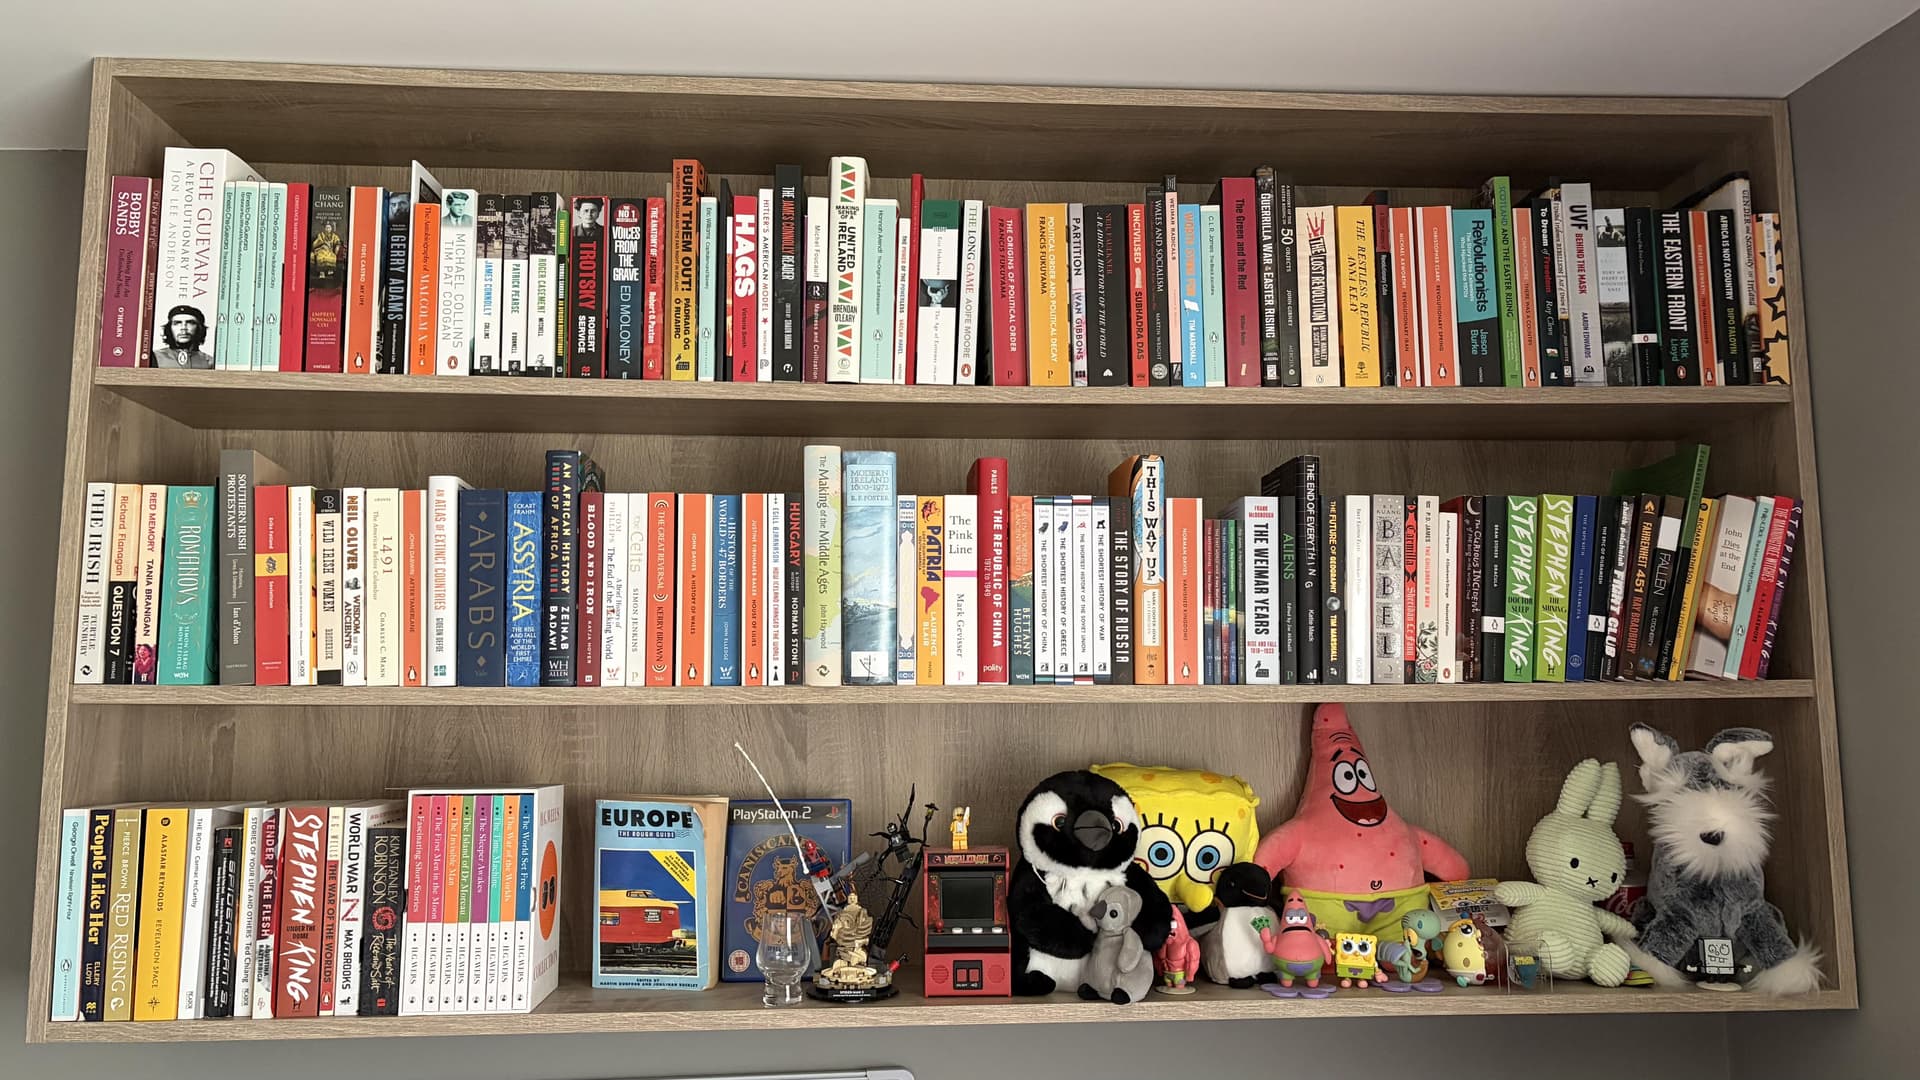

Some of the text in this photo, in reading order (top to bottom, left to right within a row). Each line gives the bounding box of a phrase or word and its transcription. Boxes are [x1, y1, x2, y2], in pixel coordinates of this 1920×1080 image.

[116, 192, 129, 236] SANDS
[129, 192, 142, 238] BOBBY
[166, 170, 182, 288] JON LEE ANDERSON
[182, 172, 194, 273] REVOLUTIONARY
[192, 162, 215, 298] CHE GUEVARA
[612, 226, 640, 240] VOICES
[614, 240, 638, 253] FROM
[681, 165, 693, 292] BURN THEM OUT!
[837, 221, 847, 272] IRELAND
[846, 226, 856, 269] UNITED
[968, 206, 977, 226] THE
[968, 229, 977, 260] LONG
[1569, 204, 1588, 231] UVF
[179, 276, 188, 299] LIFE
[387, 235, 406, 320] GERRY ADAMS
[578, 241, 597, 310] TROTSKY
[613, 268, 639, 281] GRAVE
[618, 254, 634, 267] THE
[735, 214, 755, 297] HAGS
[966, 262, 975, 293] GAME
[1471, 220, 1487, 312] Revolutionists
[1575, 233, 1586, 295] BEHIND THE MASK
[1662, 212, 1688, 332] THE EASTERN FRONT
[442, 241, 454, 341] TIM PAT COOGAN
[453, 234, 466, 349] MICHAEL COLLINS
[618, 285, 631, 364] ED MOLONEY
[962, 326, 972, 359] MOORE
[1470, 330, 1478, 355] Burke
[1479, 329, 1488, 355] Jason
[86, 489, 105, 583] THE IRISH
[116, 496, 128, 576] Richard Flanagan
[147, 512, 156, 552] MEMORY
[227, 474, 236, 539] PROTESTANTS
[238, 474, 247, 550] SOUTHERN IRISH
[346, 496, 358, 570] NEIL OLIVER
[550, 496, 559, 560] OF AFRICA
[561, 463, 571, 593] AN AFRICAN HISTORY
[789, 502, 800, 567] HUNGARY
[949, 531, 973, 541] Pink
[950, 516, 971, 525] The
[322, 520, 335, 613] WILD IRISH WOMEN
[380, 536, 393, 574] 1491
[512, 520, 535, 621] ASSYRIA
[586, 505, 595, 615] BLOOD AND IRON
[926, 526, 941, 581] PATRIA
[949, 545, 972, 554] Line
[993, 509, 1002, 647] THE REPUBLIC OF CHINA
[1254, 523, 1269, 635] THE WEIMAR YEARS
[1508, 496, 1537, 598] STEPHEN
[1634, 522, 1653, 593] FAHRENHEIT 451
[110, 585, 124, 645] QUESTION
[143, 559, 154, 637] TANIA BRANIGAN
[468, 525, 496, 648] ARABS
[1114, 530, 1129, 663] THE STORY OF RUSSIA
[549, 606, 558, 650] BADAWI
[560, 606, 570, 650] ZEINAB
[631, 613, 639, 652] JENKINS
[791, 598, 799, 665] NORMAN STONE
[1505, 612, 1533, 667] KING
[601, 808, 693, 828] EUROPE
[88, 815, 110, 945] People Like Her
[157, 834, 168, 912] ALASTAIR REYNOLDS
[261, 818, 276, 938] TENDER IS THE FLESH
[288, 808, 323, 925] STEPHEN
[341, 813, 361, 921] WORLD WAR Z
[373, 836, 389, 905] ROBINSON
[388, 835, 400, 904] KIM STANLEY
[477, 818, 488, 893] The Sleeper Awakes
[107, 893, 131, 993] RED RISING
[280, 939, 316, 1000] KING
[341, 930, 353, 990] MAX BROOKS
